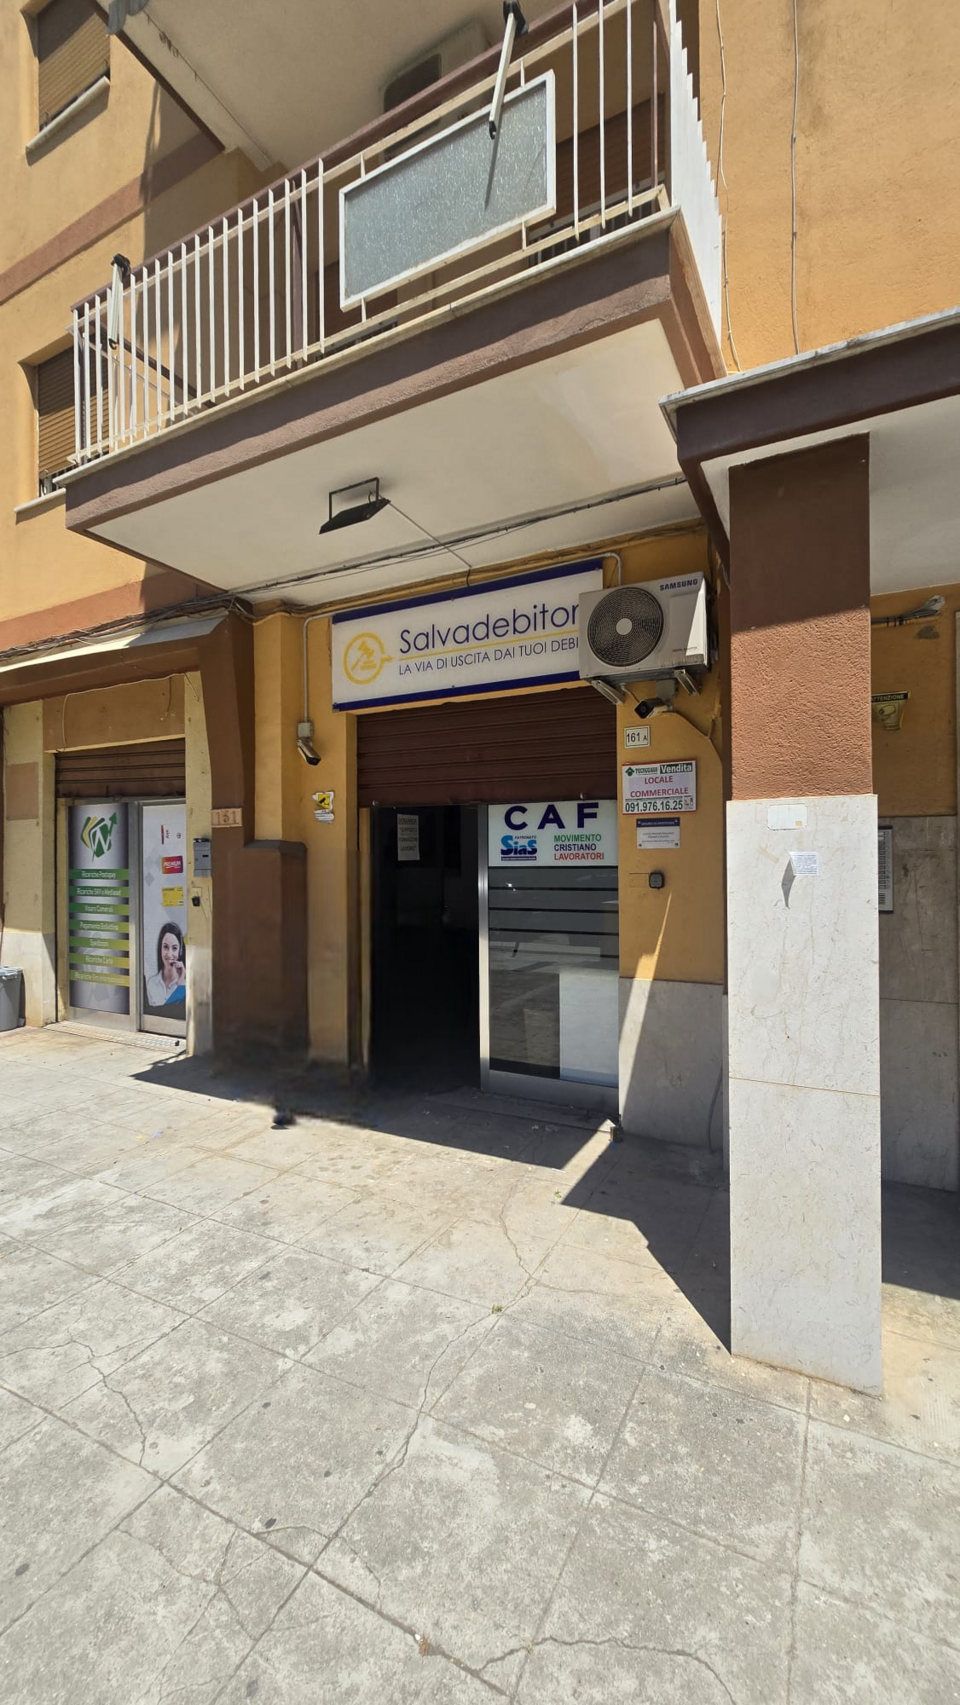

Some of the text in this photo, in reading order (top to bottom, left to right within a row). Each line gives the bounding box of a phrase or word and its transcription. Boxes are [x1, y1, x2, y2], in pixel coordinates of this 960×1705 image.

[660, 579, 698, 591] SAMSUNG
[399, 603, 579, 654] Salvadebitor
[399, 637, 579, 676] LA VIA DI USCITA DAI TUOI DEBI
[626, 732, 640, 742] 161
[660, 763, 692, 773] Vendita
[644, 775, 674, 785] LOCALE
[630, 787, 689, 798] COMMERCIALE
[625, 800, 683, 813] 091.976.16.25
[504, 802, 599, 831] CAF
[554, 834, 602, 843] MOVIMENTO
[554, 843, 597, 852] CRISTIANO
[554, 852, 605, 861] LAVORATORI
